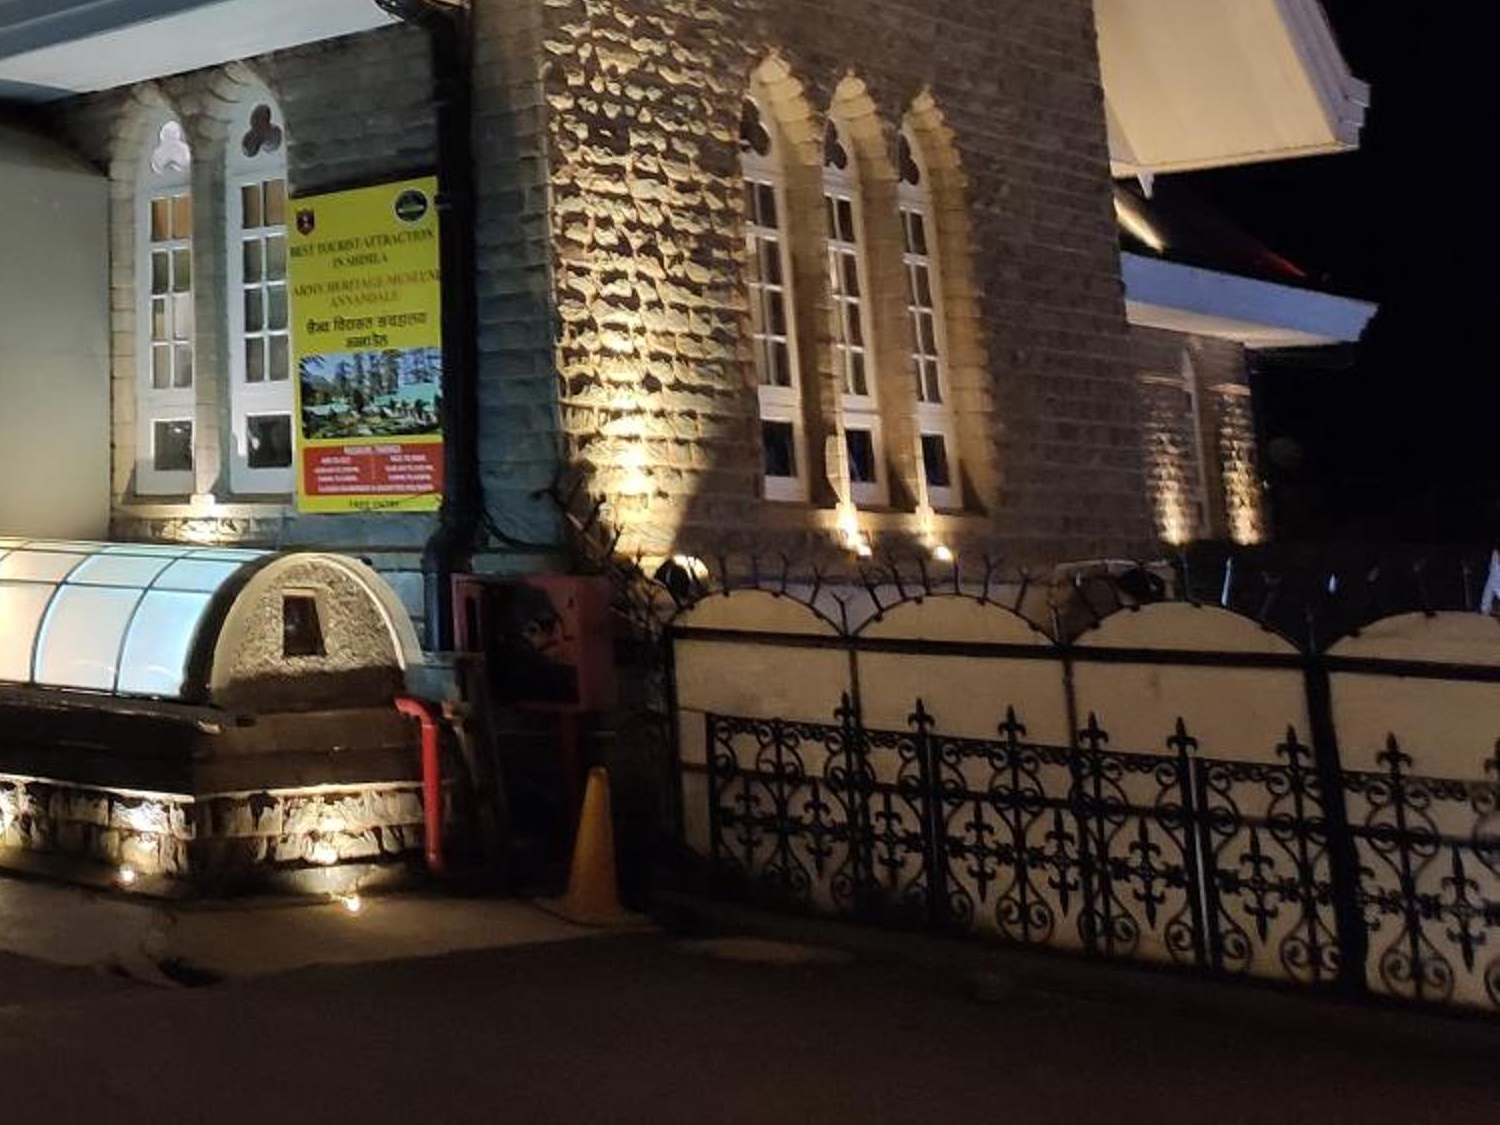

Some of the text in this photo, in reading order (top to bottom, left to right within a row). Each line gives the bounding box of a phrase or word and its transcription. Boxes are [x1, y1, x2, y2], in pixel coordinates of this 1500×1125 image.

[317, 237, 360, 253] TOURIST
[363, 228, 436, 248] ATTRACTION
[327, 275, 382, 292] HERITAGE
